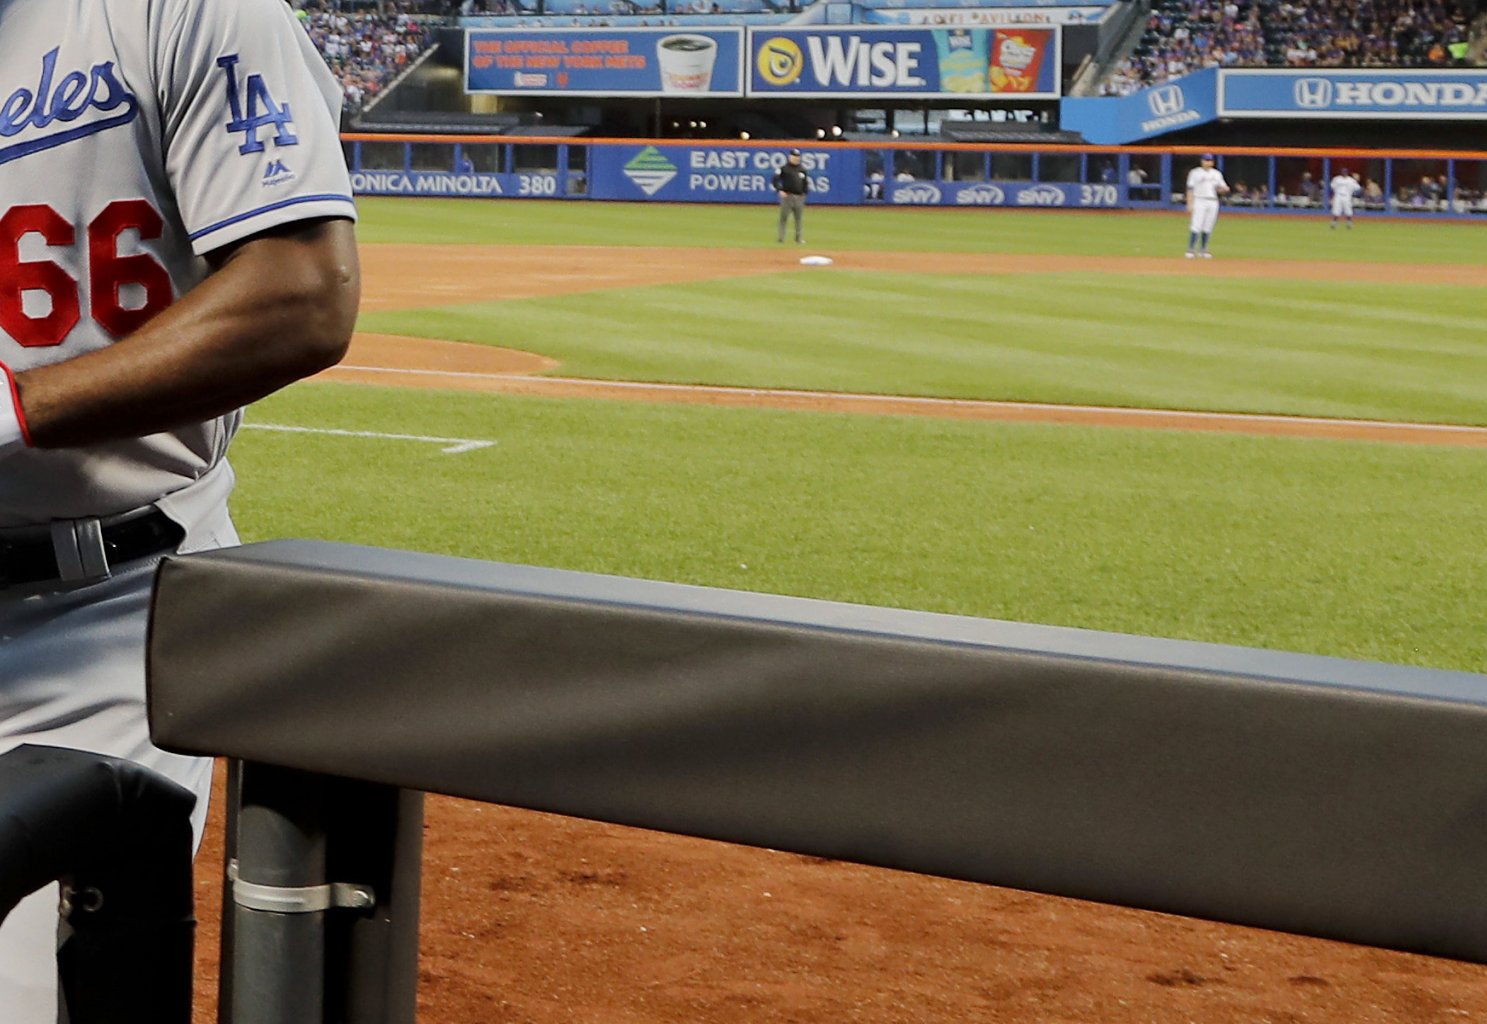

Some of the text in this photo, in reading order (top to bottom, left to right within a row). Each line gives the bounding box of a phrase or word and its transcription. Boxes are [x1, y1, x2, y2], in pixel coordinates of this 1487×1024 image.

[526, 56, 561, 69] NEW
[807, 35, 923, 87] WISE
[216, 52, 300, 156] LA
[1141, 109, 1201, 133] HONDA
[690, 150, 831, 171] EAST COST
[353, 173, 503, 194] ONICA MINOLTA
[518, 175, 557, 195] 380
[689, 175, 766, 192] POWER
[1080, 184, 1118, 205] 370
